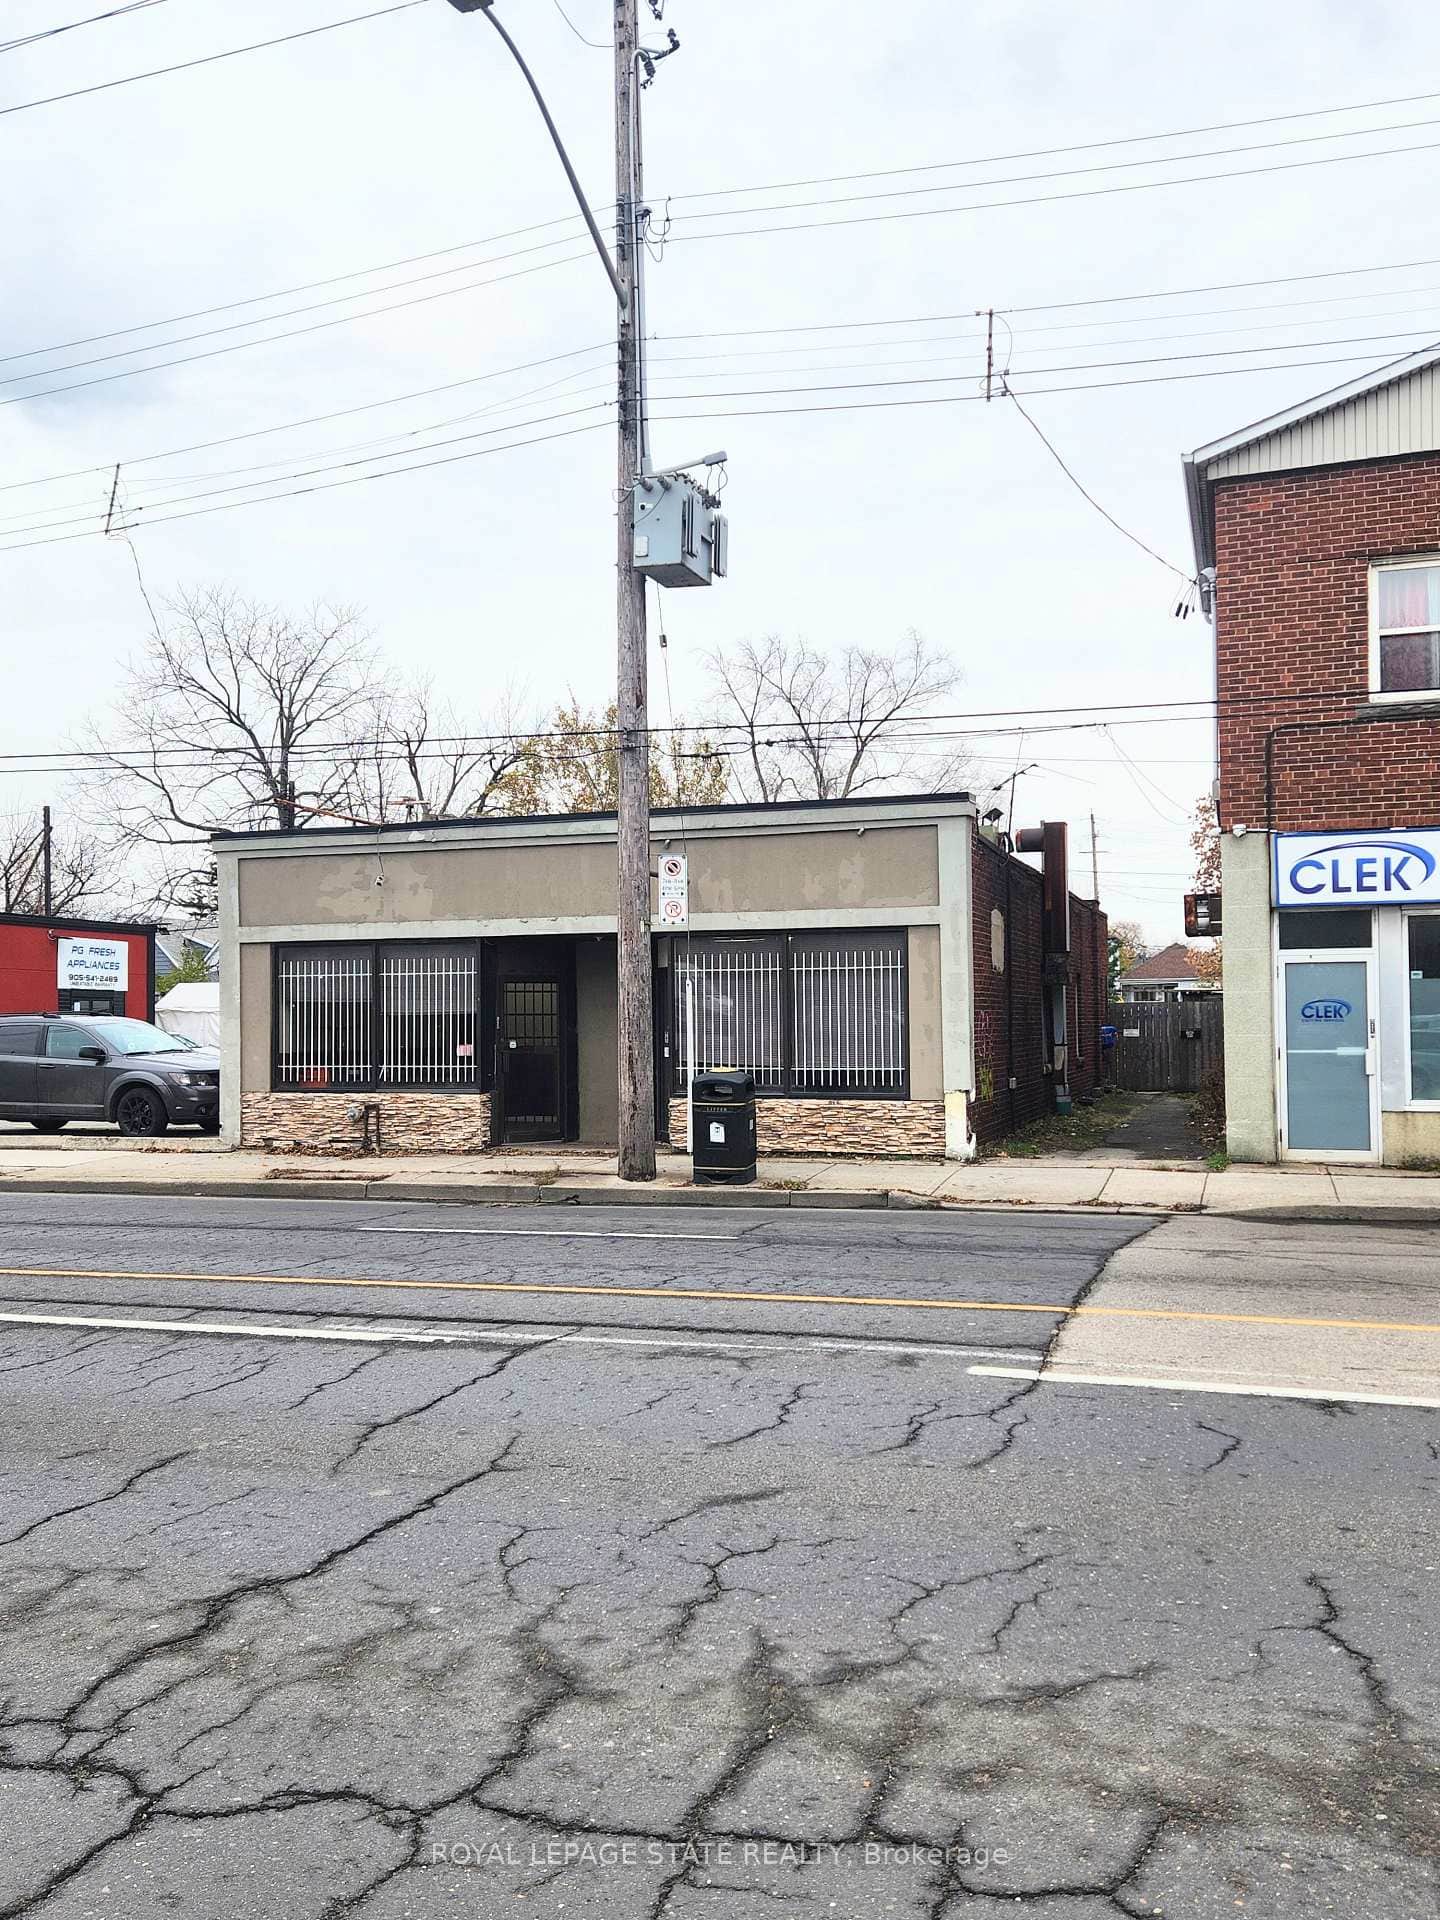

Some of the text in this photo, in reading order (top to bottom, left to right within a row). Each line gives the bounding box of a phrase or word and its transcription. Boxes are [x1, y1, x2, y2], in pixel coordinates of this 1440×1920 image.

[1290, 857, 1412, 894] CLEK
[71, 946, 116, 957] PG FRESH
[67, 960, 120, 970] APPLIANCES
[1301, 1005, 1343, 1018] CLEK
